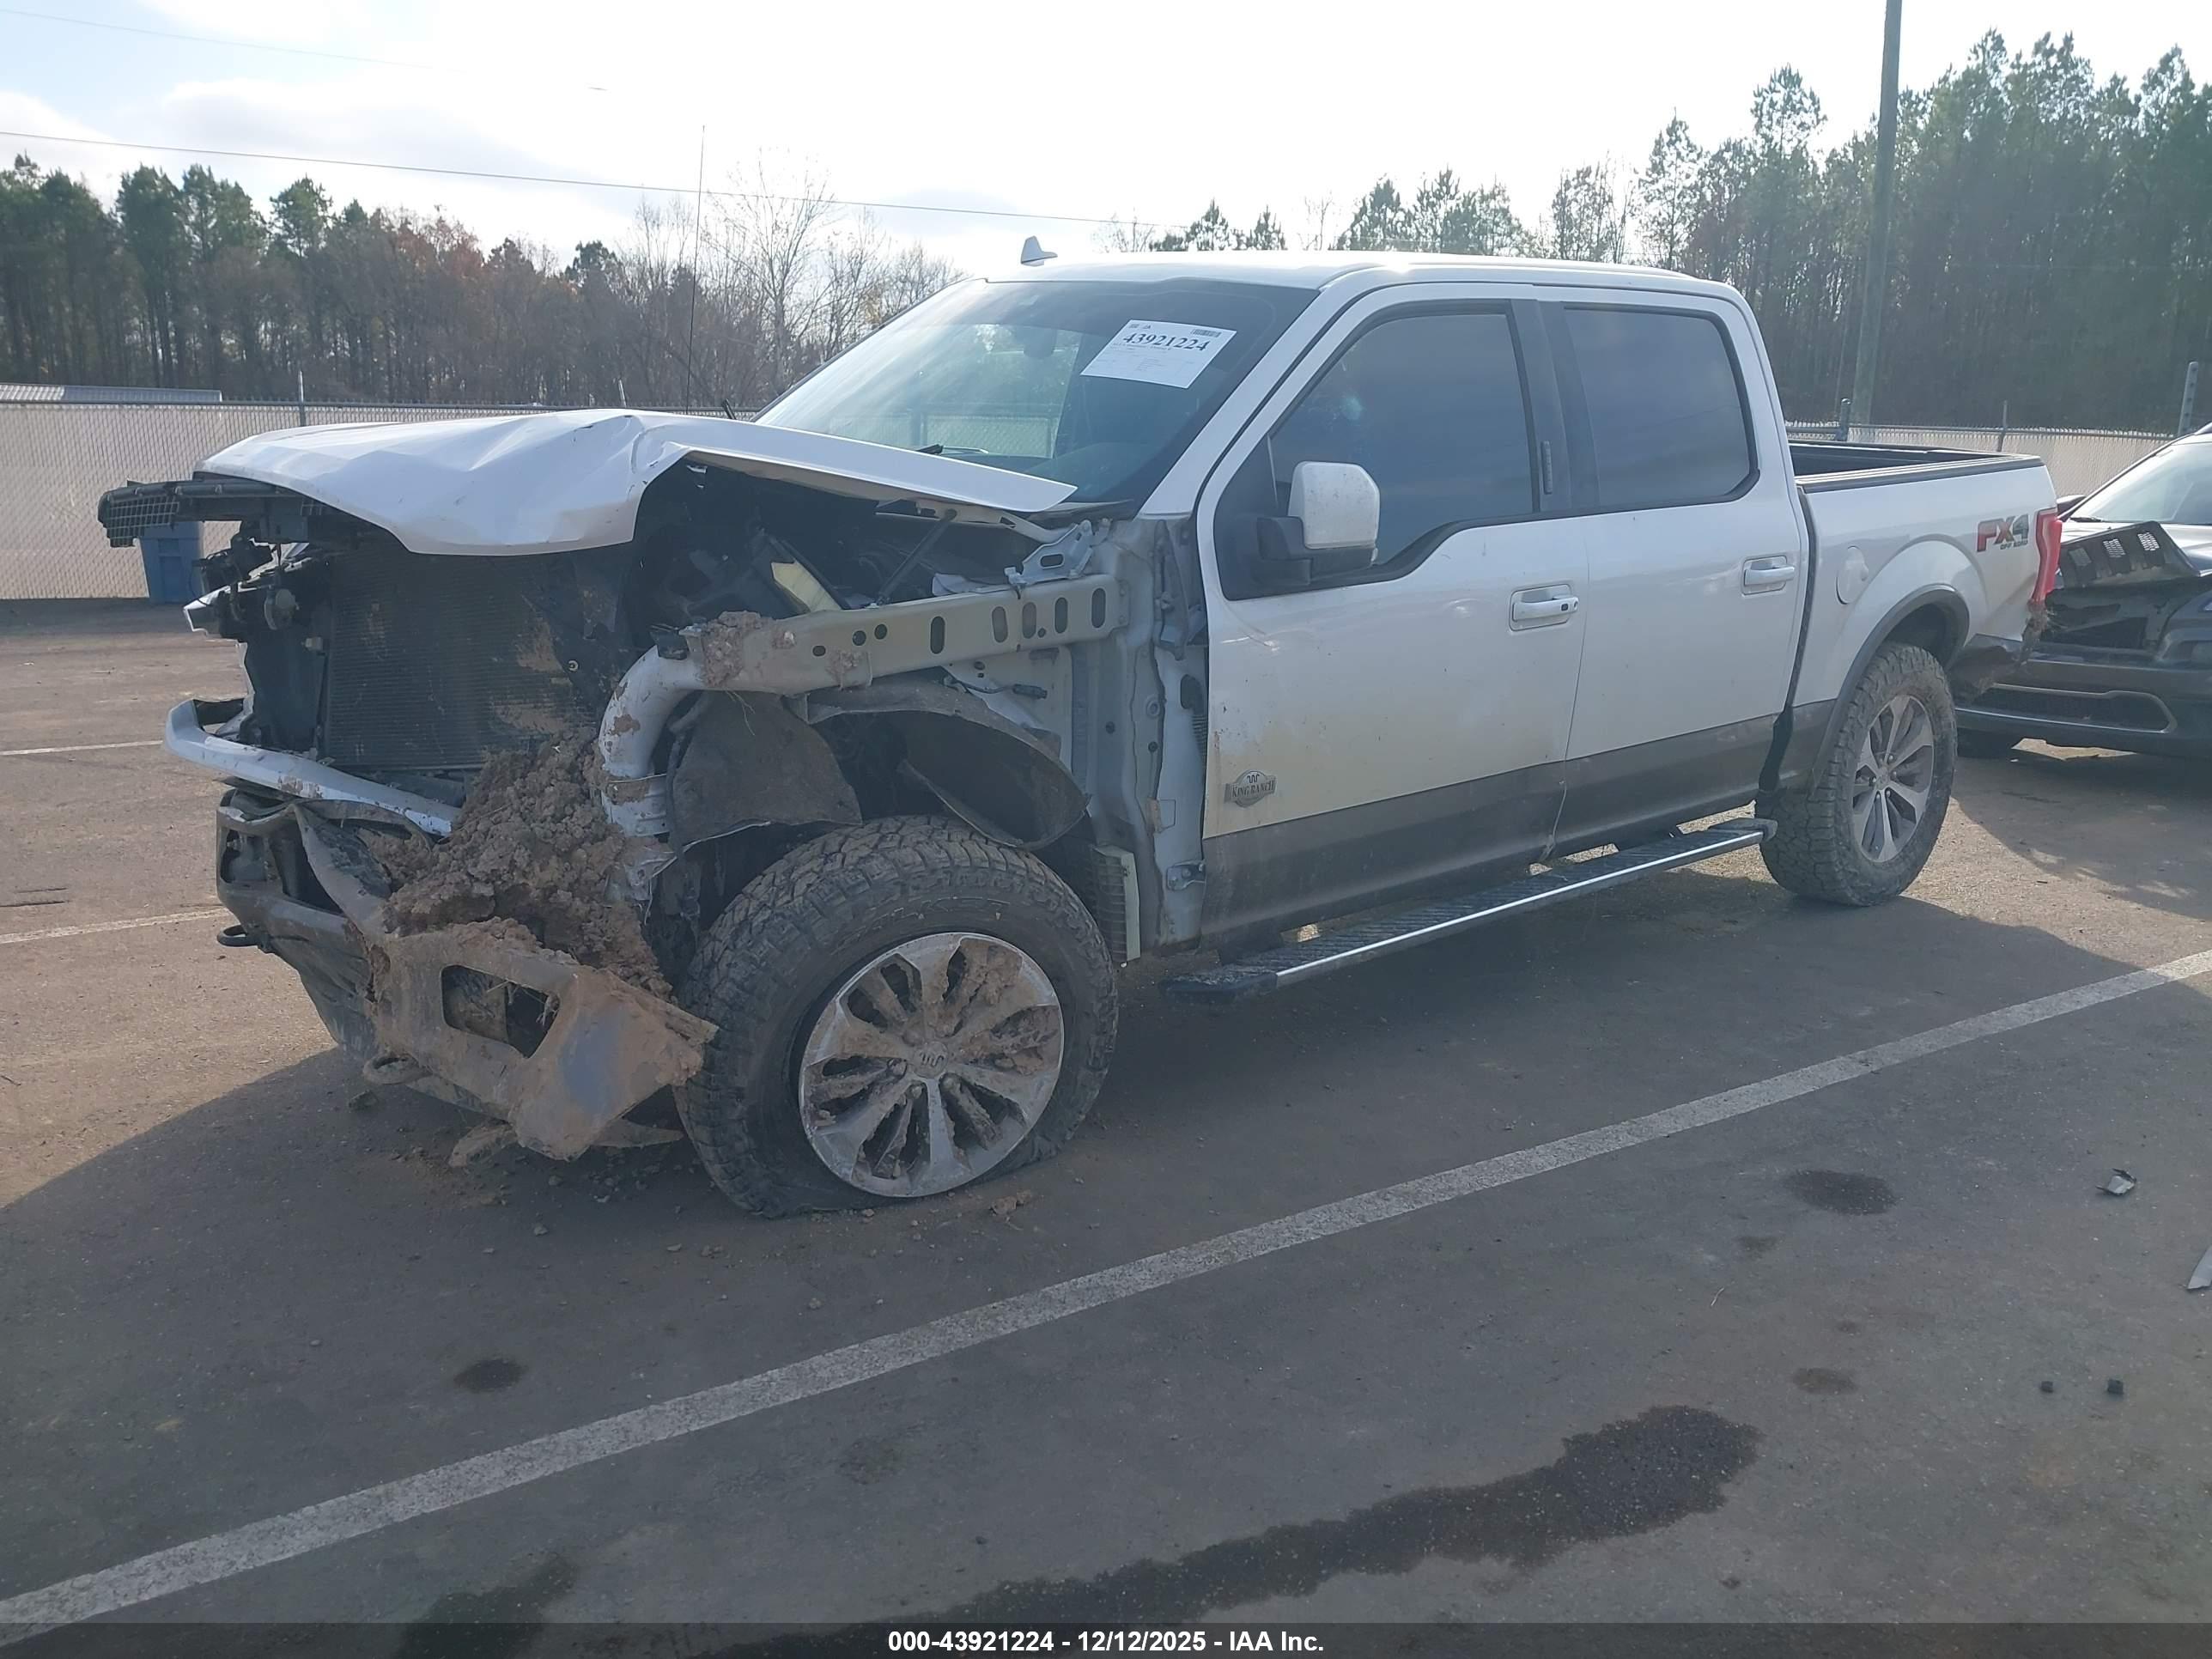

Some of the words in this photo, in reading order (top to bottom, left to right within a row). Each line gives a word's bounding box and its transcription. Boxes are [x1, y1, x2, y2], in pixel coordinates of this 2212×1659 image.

[1123, 332, 1210, 351] 43921224
[1977, 514, 2028, 552] FX4
[1231, 785, 1249, 798] KING
[1250, 780, 1274, 793] RANCH
